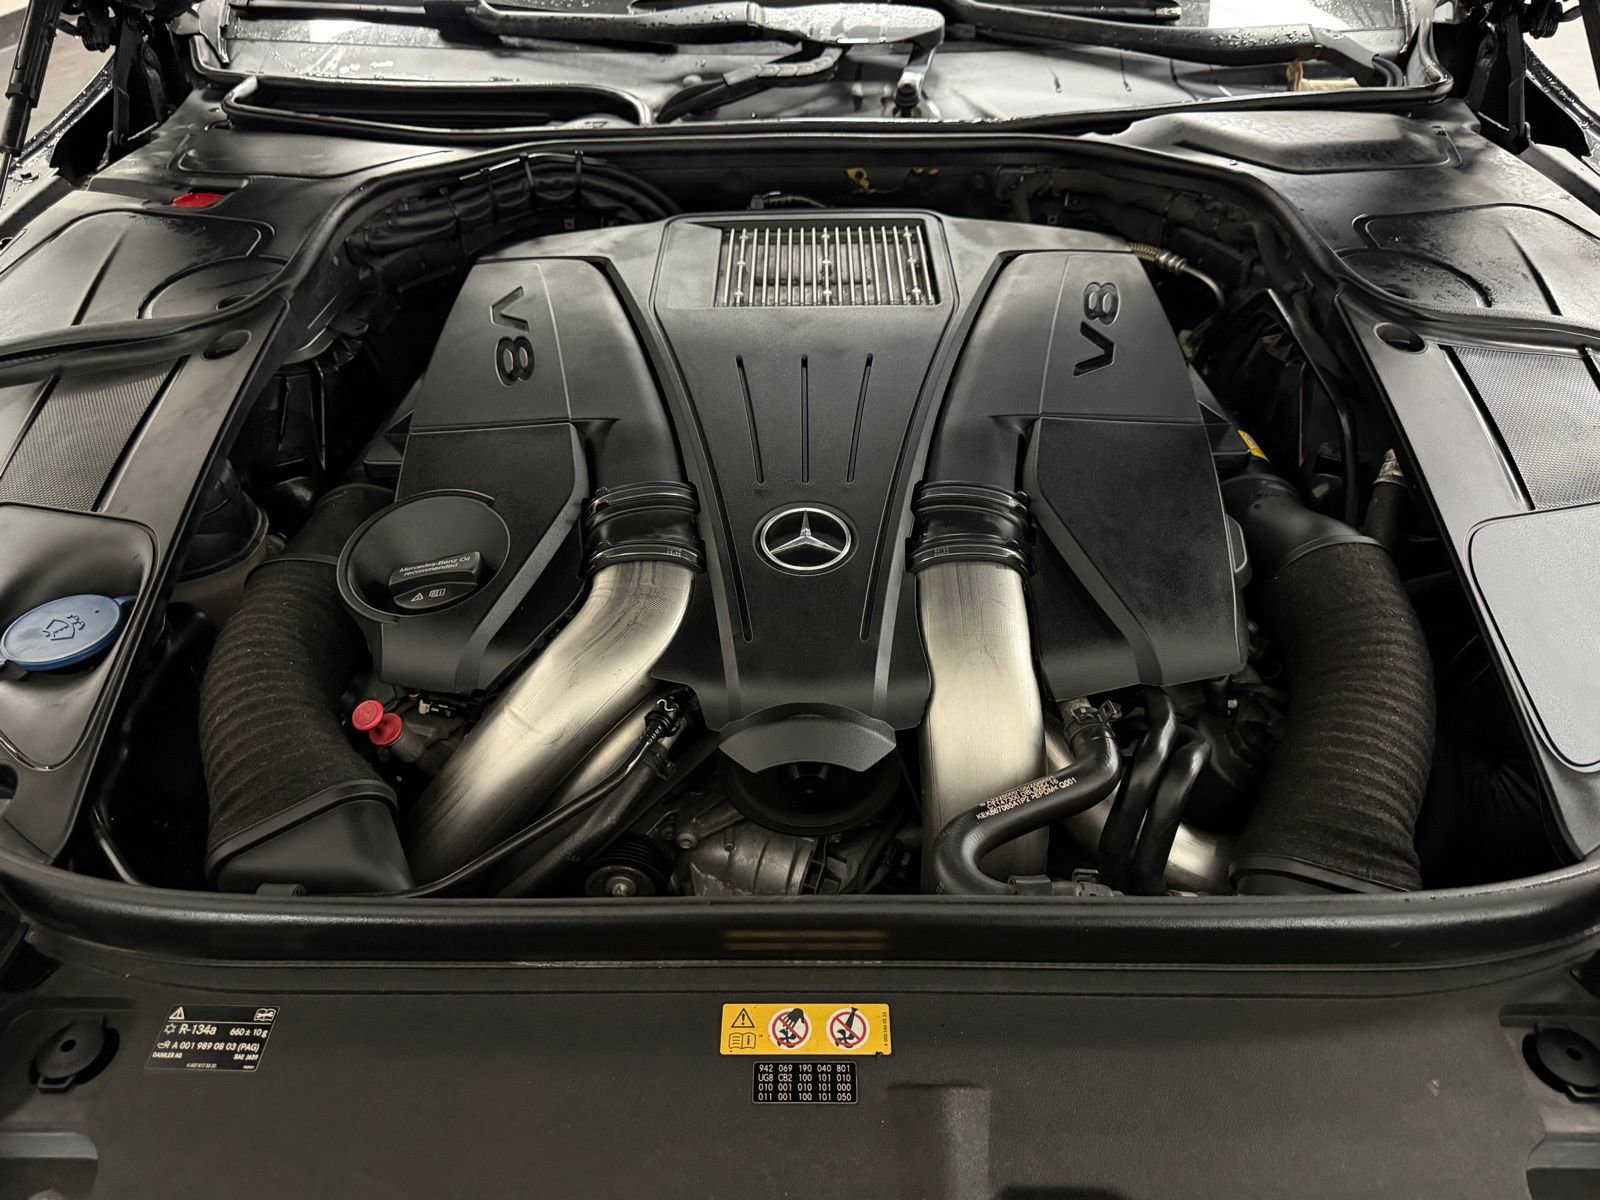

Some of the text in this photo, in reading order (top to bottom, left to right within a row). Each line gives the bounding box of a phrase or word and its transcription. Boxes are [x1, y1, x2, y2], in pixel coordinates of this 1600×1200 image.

[1073, 281, 1121, 377] V8
[490, 285, 535, 388] V8
[399, 558, 459, 573] Mercedes-Benz
[403, 562, 459, 576] recommended
[178, 1023, 218, 1035] R-134a
[179, 1041, 194, 1050] 001
[196, 1042, 212, 1050] 989
[213, 1042, 224, 1050] 08
[225, 1042, 237, 1051] 03
[237, 1042, 260, 1053] (PAG)
[759, 1064, 850, 1072] 942 069 190 040 801
[798, 1073, 812, 1082] 100
[818, 1073, 831, 1082] 101
[836, 1073, 851, 1082] 010
[758, 1083, 852, 1091] 010 001 010 101 000
[758, 1092, 852, 1101] 011 001 100 101 050
